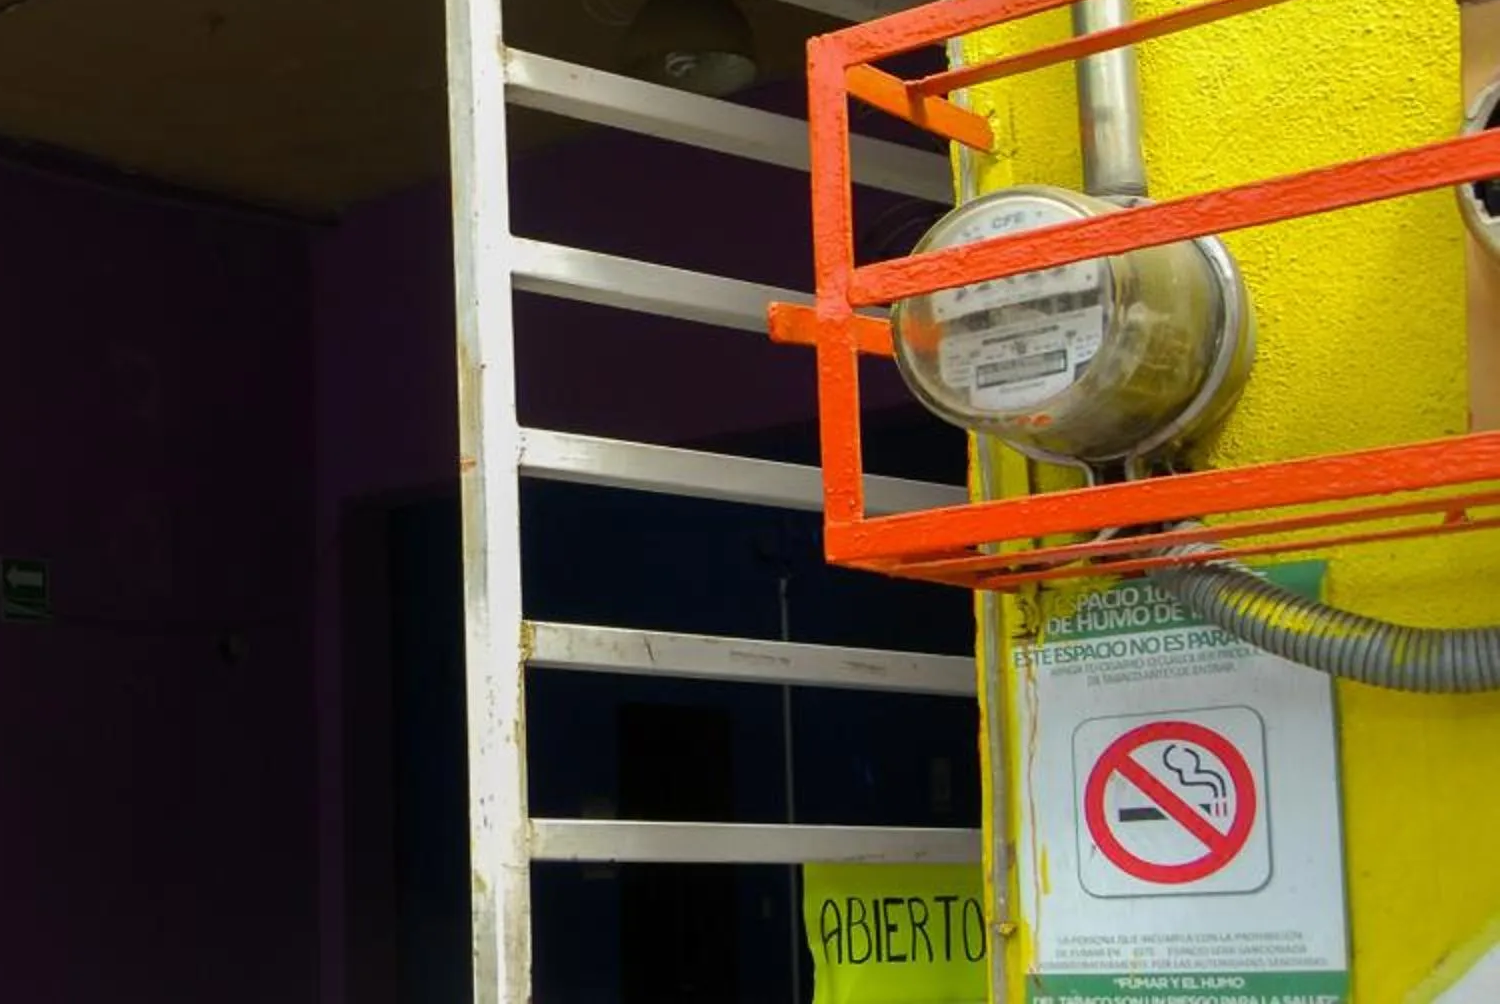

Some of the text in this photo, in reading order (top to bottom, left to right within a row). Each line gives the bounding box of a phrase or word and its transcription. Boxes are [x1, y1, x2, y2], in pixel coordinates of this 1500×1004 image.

[1047, 616, 1073, 635] DE
[1077, 606, 1151, 632] HUMO
[1154, 602, 1186, 624] DE
[1054, 640, 1128, 664] ESPACIO
[1129, 636, 1161, 657] NO
[1163, 633, 1186, 652] ES
[820, 895, 987, 964] ABIERTO
[1181, 977, 1201, 989] EL
[1202, 976, 1246, 989] HUMO
